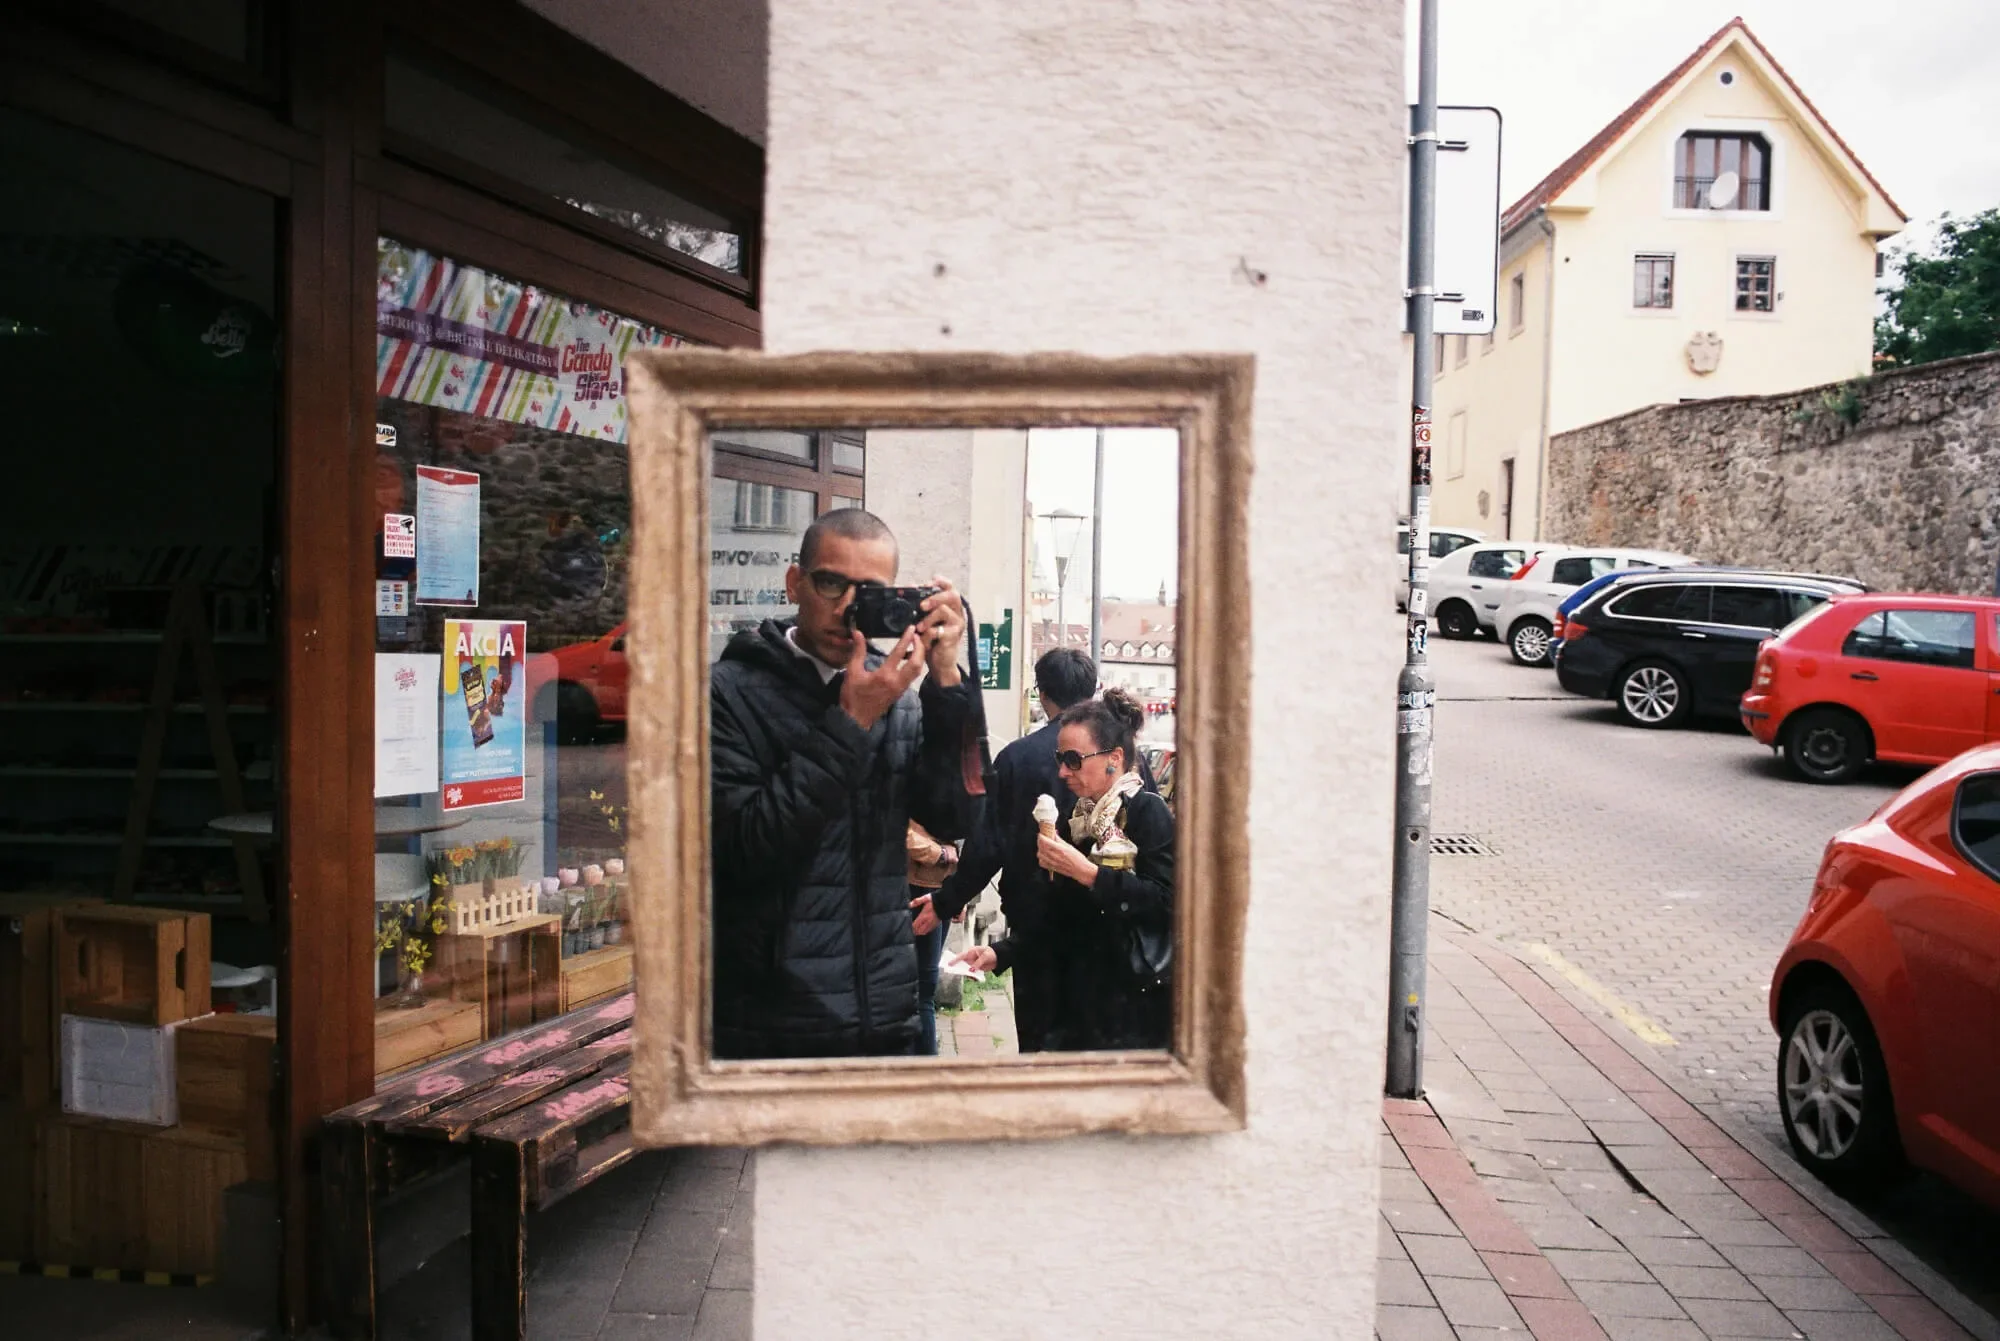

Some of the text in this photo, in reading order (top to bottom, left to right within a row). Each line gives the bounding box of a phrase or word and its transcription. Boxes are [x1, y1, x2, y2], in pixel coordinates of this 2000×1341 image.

[576, 337, 590, 352] The
[562, 342, 612, 381] Candy
[575, 373, 619, 401] Store
[454, 632, 516, 657] AKCIA
